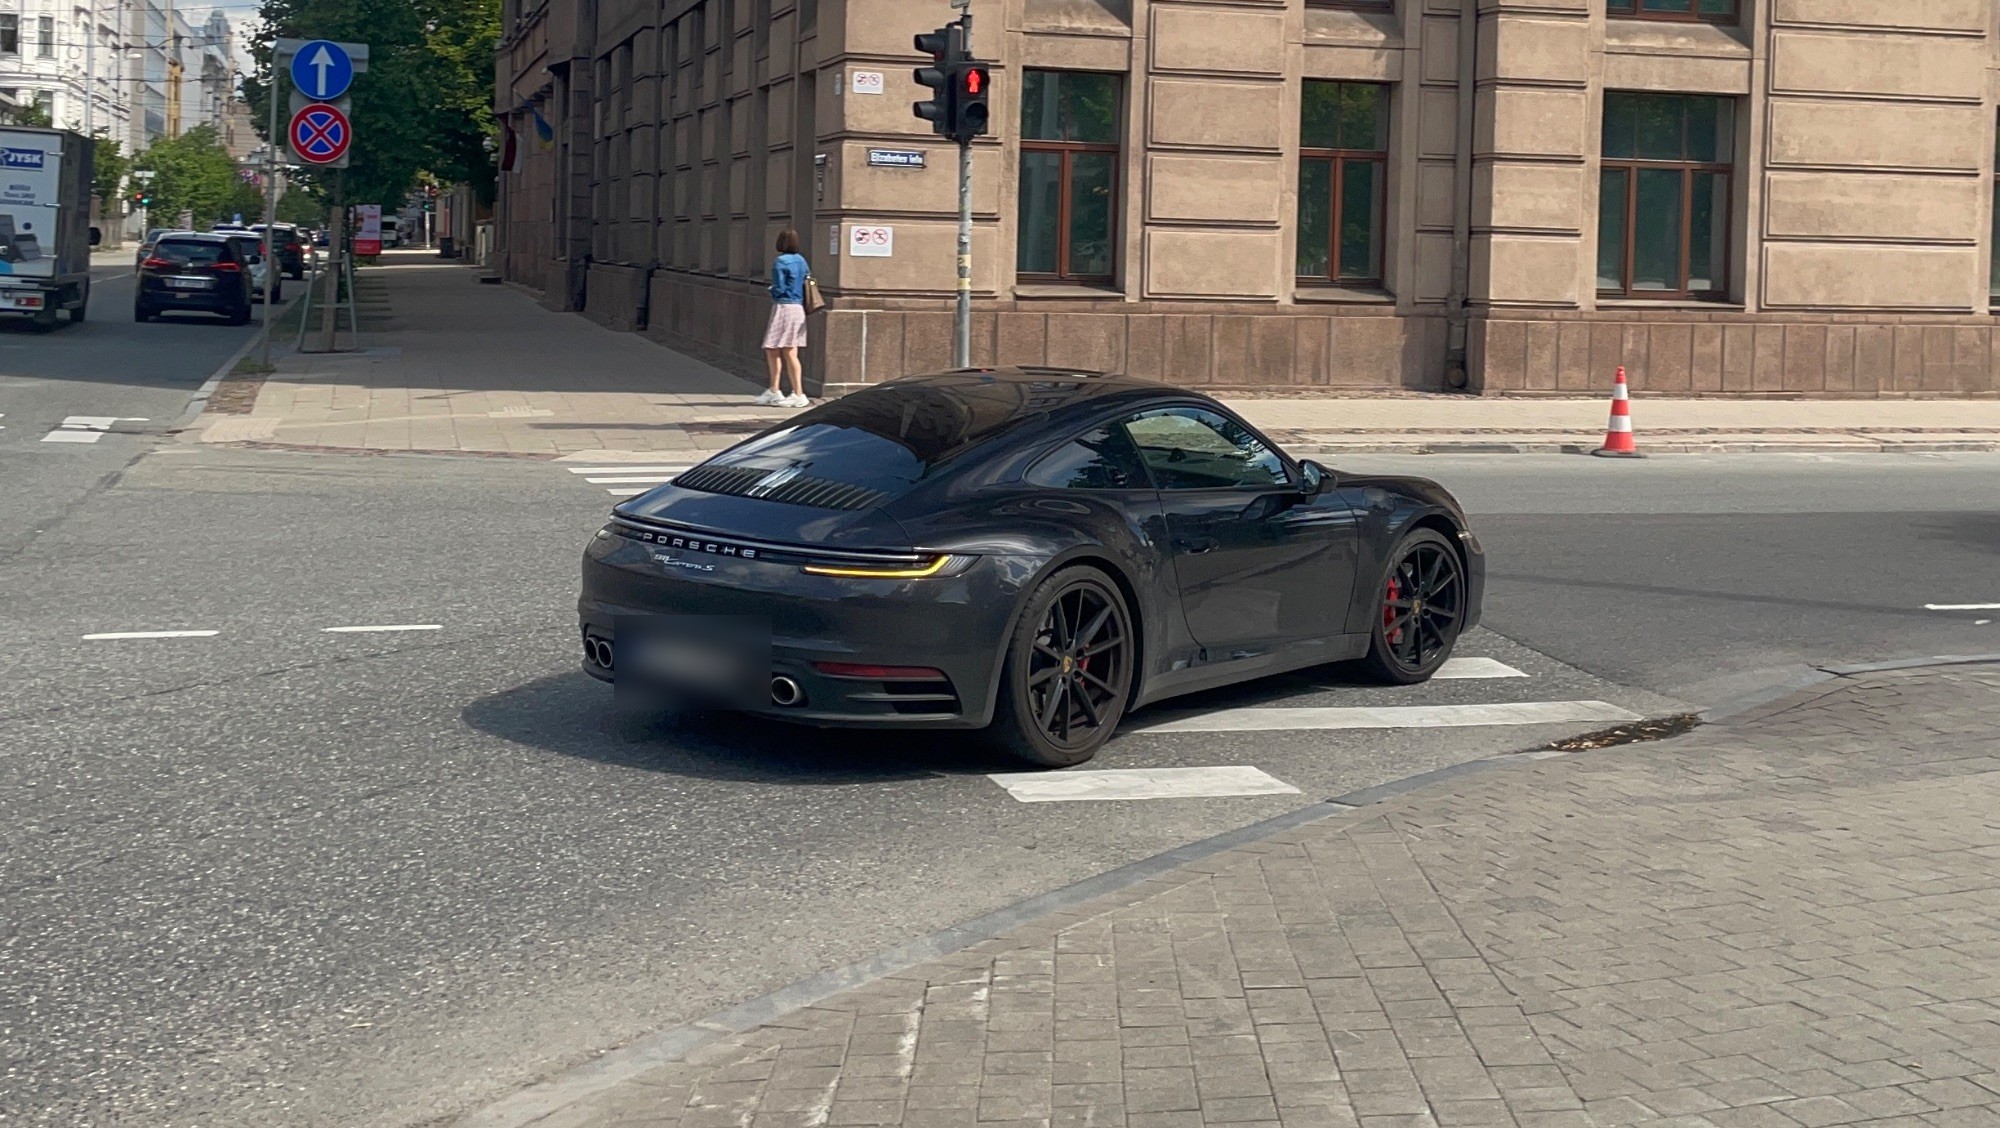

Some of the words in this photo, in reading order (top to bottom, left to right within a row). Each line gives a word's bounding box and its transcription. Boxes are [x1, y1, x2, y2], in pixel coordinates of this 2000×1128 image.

[8, 153, 42, 164] JYSK
[871, 152, 908, 163] Elizabetes
[643, 532, 755, 558] PORSCHE
